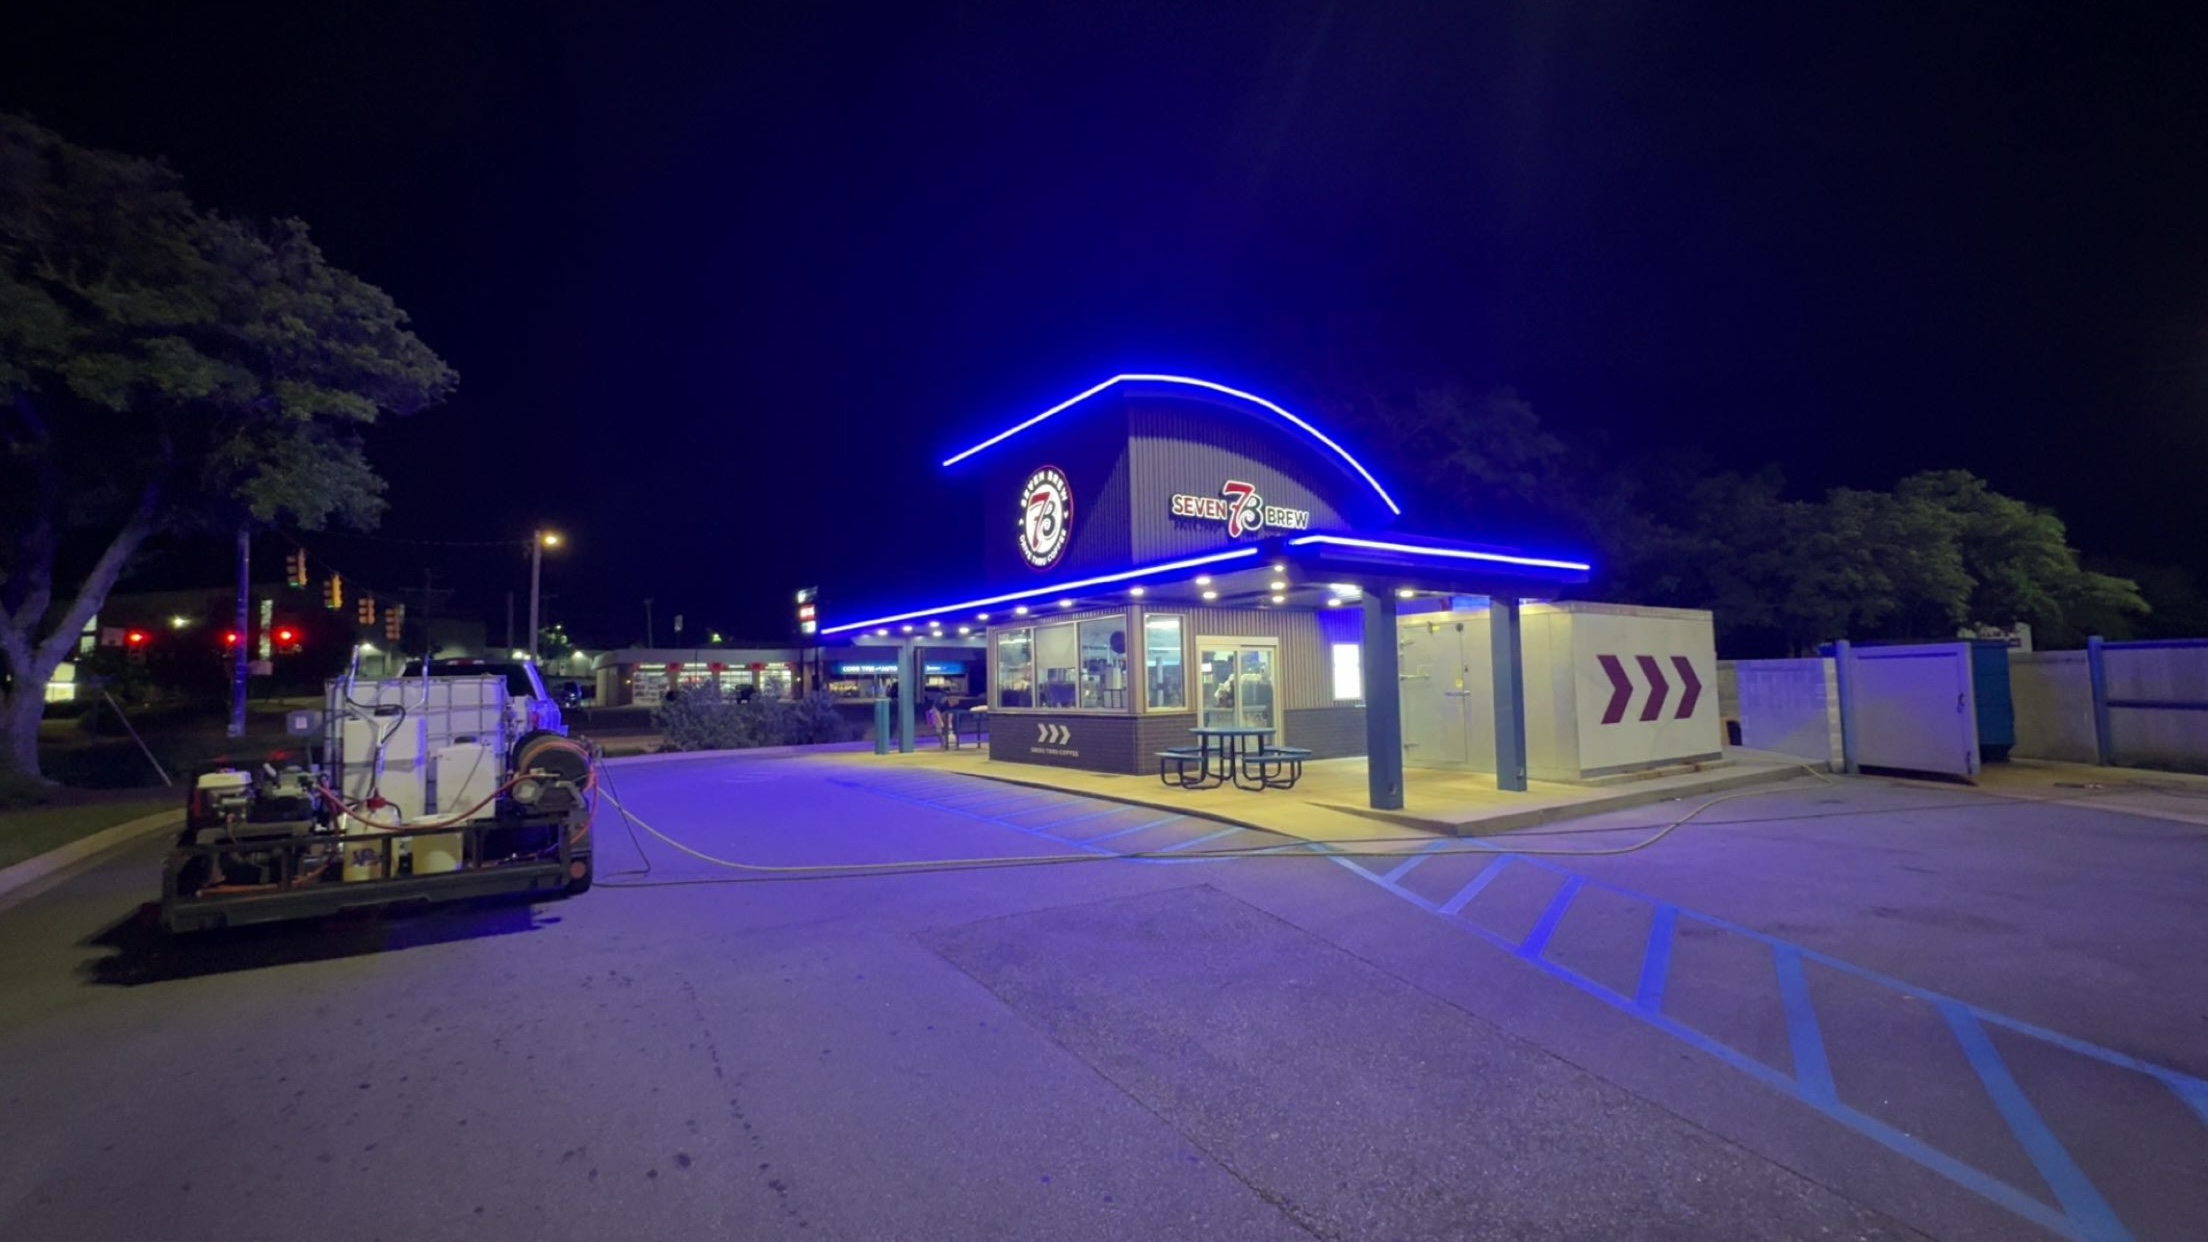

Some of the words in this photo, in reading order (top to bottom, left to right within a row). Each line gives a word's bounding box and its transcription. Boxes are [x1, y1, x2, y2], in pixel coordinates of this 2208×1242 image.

[1048, 470, 1068, 501] BREW
[1172, 494, 1228, 520] SEVEN
[1265, 505, 1310, 530] BREW
